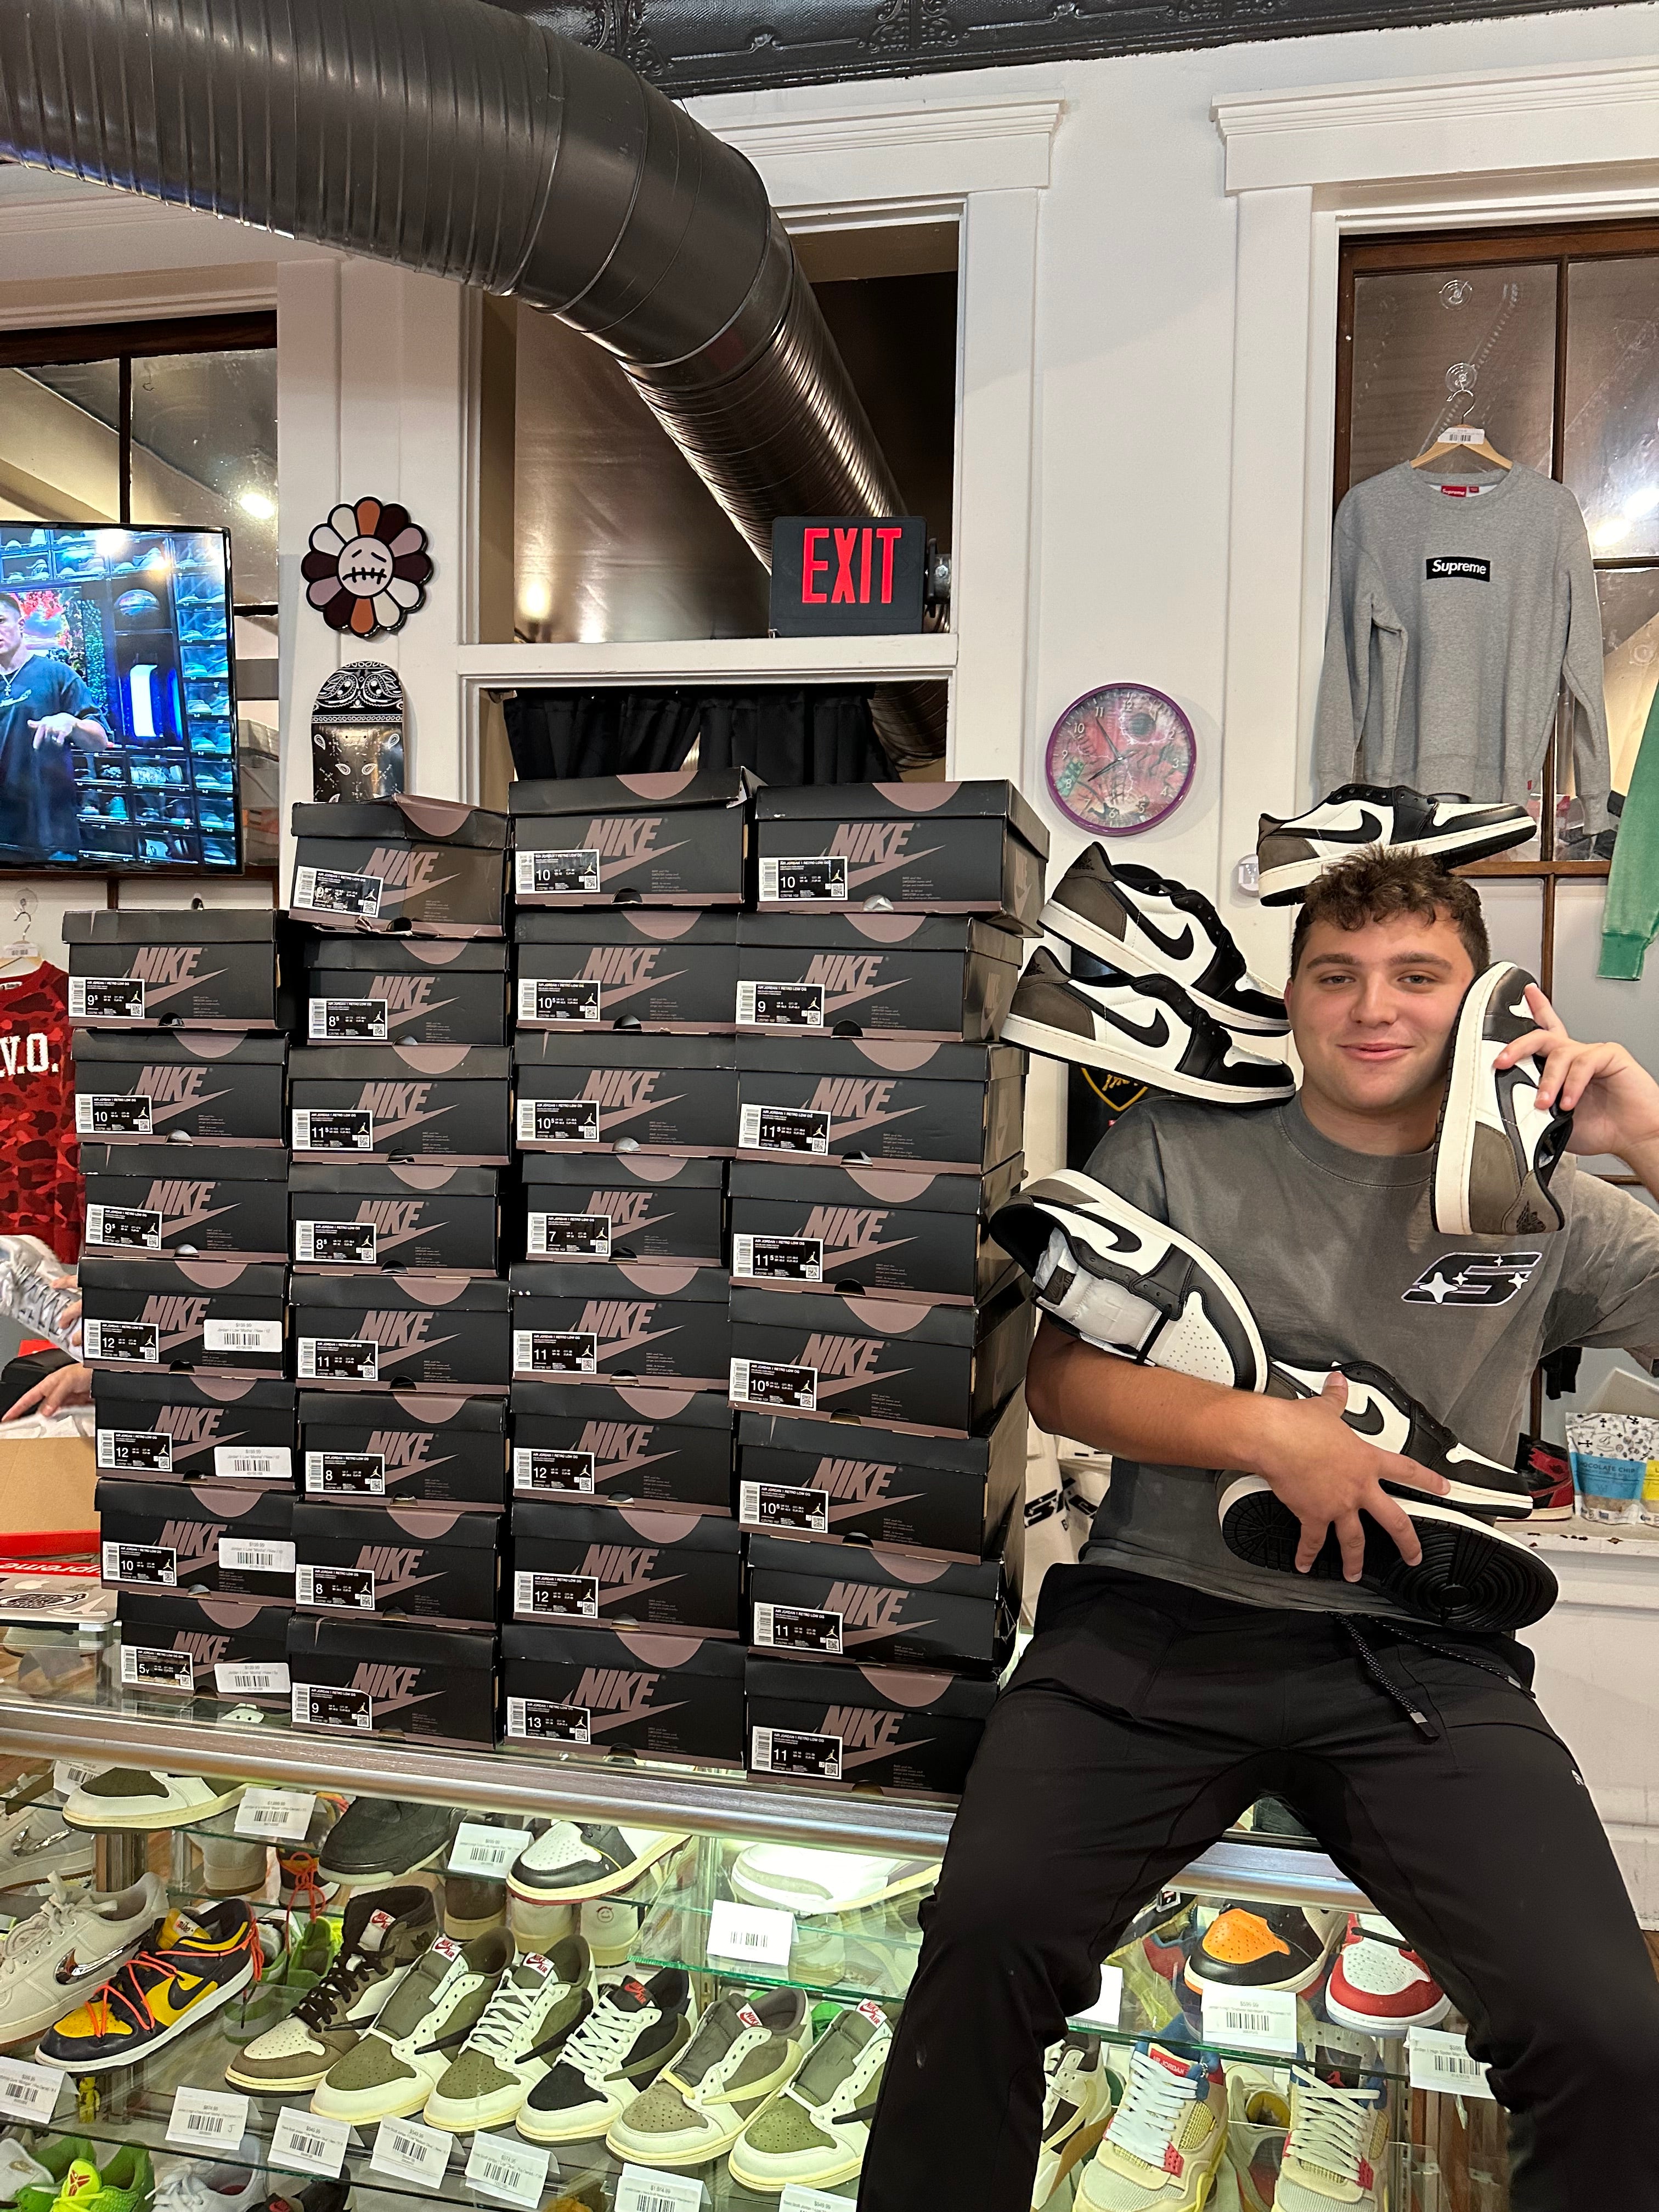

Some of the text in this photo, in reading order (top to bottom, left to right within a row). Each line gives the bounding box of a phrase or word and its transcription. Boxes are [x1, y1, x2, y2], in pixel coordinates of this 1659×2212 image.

[802, 528, 902, 603] EXIT
[1432, 560, 1486, 574] Supreme
[1074, 724, 1085, 733] 10
[1095, 707, 1104, 717] 11
[1062, 751, 1068, 760] 9
[1172, 760, 1178, 768] 3
[1066, 778, 1071, 789] 8
[583, 818, 662, 856] NIKE
[828, 823, 915, 862] NIKE
[363, 848, 439, 887] NIKE
[536, 870, 550, 881] 10
[781, 876, 795, 888] 10
[130, 947, 202, 983] NIKE
[583, 947, 662, 984] NIKE
[804, 955, 883, 991] NIKE
[368, 976, 435, 1009] NIKE
[758, 1001, 766, 1012] 9
[135, 1066, 207, 1101] NIKE
[356, 1082, 432, 1118] NIKE
[582, 1070, 660, 1107] NIKE
[810, 1077, 896, 1118] NIKE
[94, 1111, 107, 1121] 10
[145, 1181, 216, 1216] NIKE
[586, 1191, 653, 1223] NIKE
[356, 1201, 424, 1234] NIKE
[802, 1206, 889, 1246] NIKE
[549, 1232, 556, 1242] 7
[141, 1295, 211, 1331] NIKE
[358, 1311, 434, 1346] NIKE
[577, 1301, 656, 1338] NIKE
[103, 1338, 114, 1348] 12
[534, 1349, 546, 1359] 11
[799, 1333, 884, 1375] NIKE
[318, 1356, 329, 1367] 11
[155, 1406, 224, 1442] NIKE
[578, 1421, 654, 1460] NIKE
[116, 1447, 128, 1457] 12
[365, 1431, 433, 1465] NIKE
[325, 1470, 332, 1481] 8
[533, 1467, 546, 1479] 12
[810, 1457, 897, 1500] NIKE
[159, 1520, 227, 1556] NIKE
[121, 1560, 133, 1571] 10
[356, 1545, 424, 1581] NIKE
[580, 1544, 659, 1583] NIKE
[316, 1584, 323, 1594] 8
[535, 1592, 549, 1602] 12
[823, 1582, 910, 1627] NIKE
[173, 1631, 230, 1663] NIKE
[776, 1625, 788, 1637] 11
[352, 1663, 420, 1699] NIKE
[572, 1668, 659, 1711] NIKE
[312, 1703, 319, 1713] 9
[527, 1717, 541, 1728] 13
[820, 1705, 905, 1748] NIKE
[774, 1749, 786, 1760] 11
[532, 1954, 546, 1962] NIKE
[1161, 2061, 1184, 2074] JORDAN
